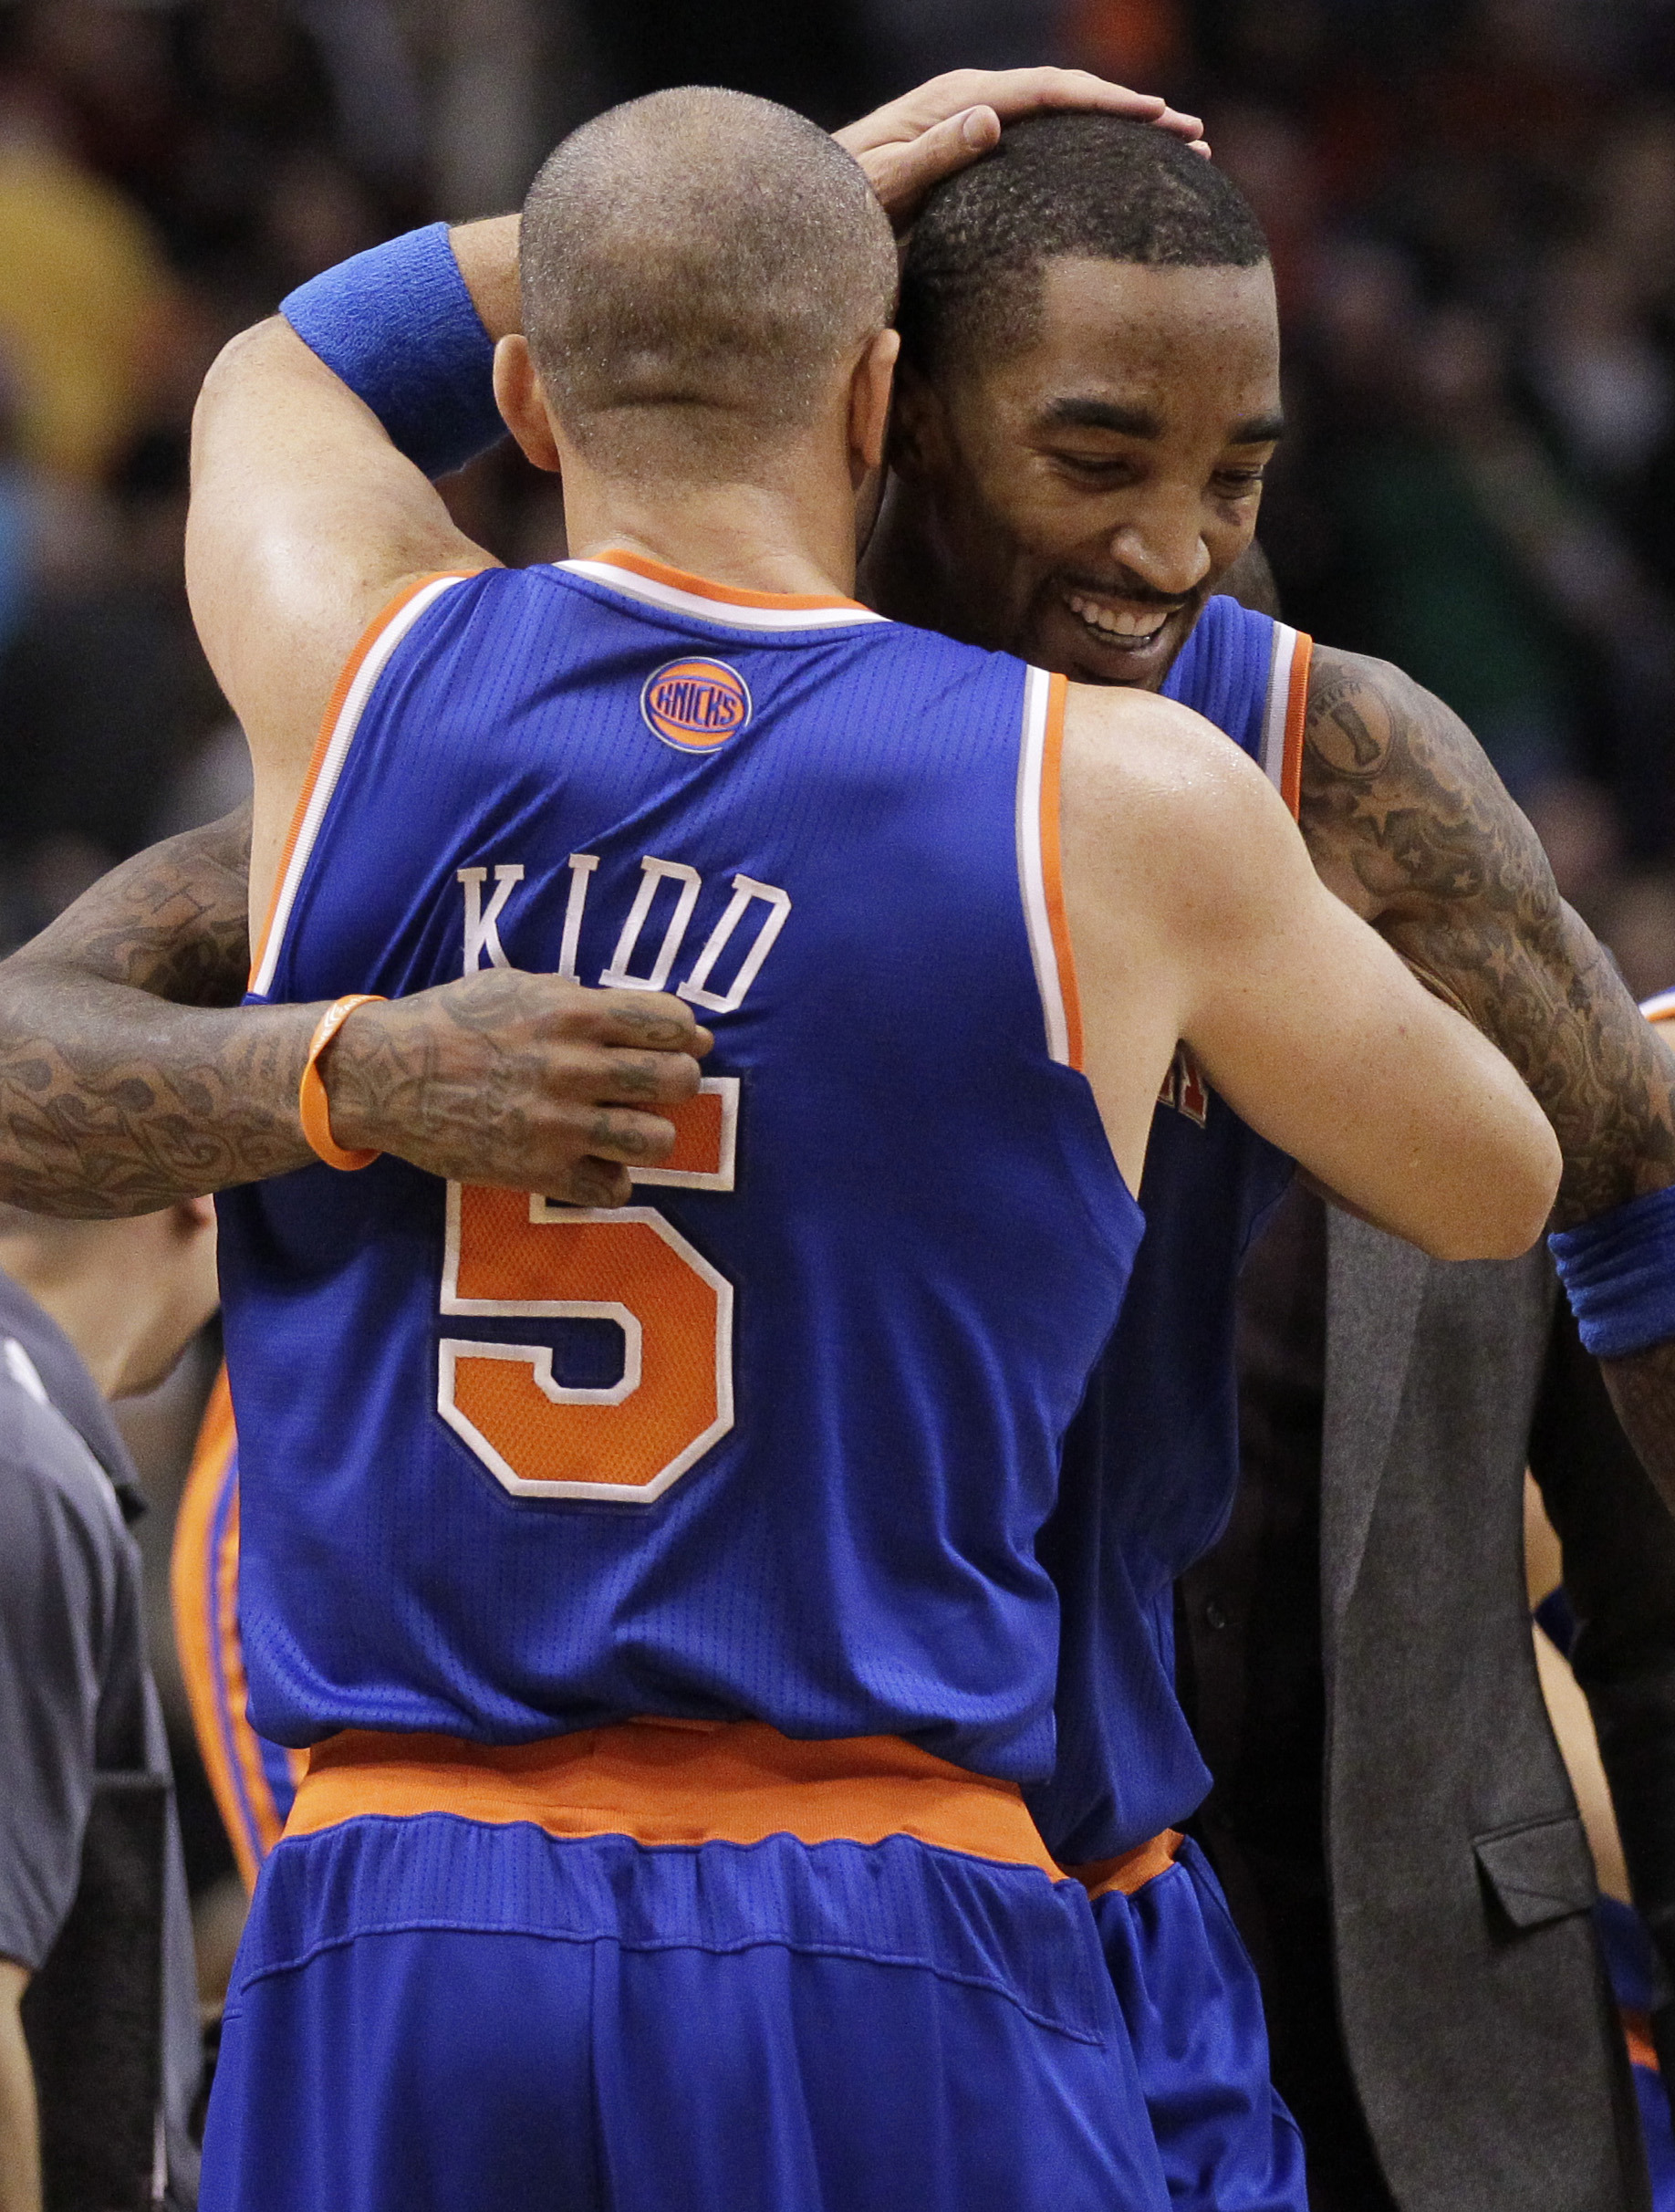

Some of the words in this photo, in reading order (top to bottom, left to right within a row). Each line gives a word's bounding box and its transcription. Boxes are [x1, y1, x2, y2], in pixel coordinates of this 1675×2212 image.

[657, 683, 736, 727] KNICKS
[457, 853, 792, 1014] KIDD
[438, 1077, 740, 1503] 5
